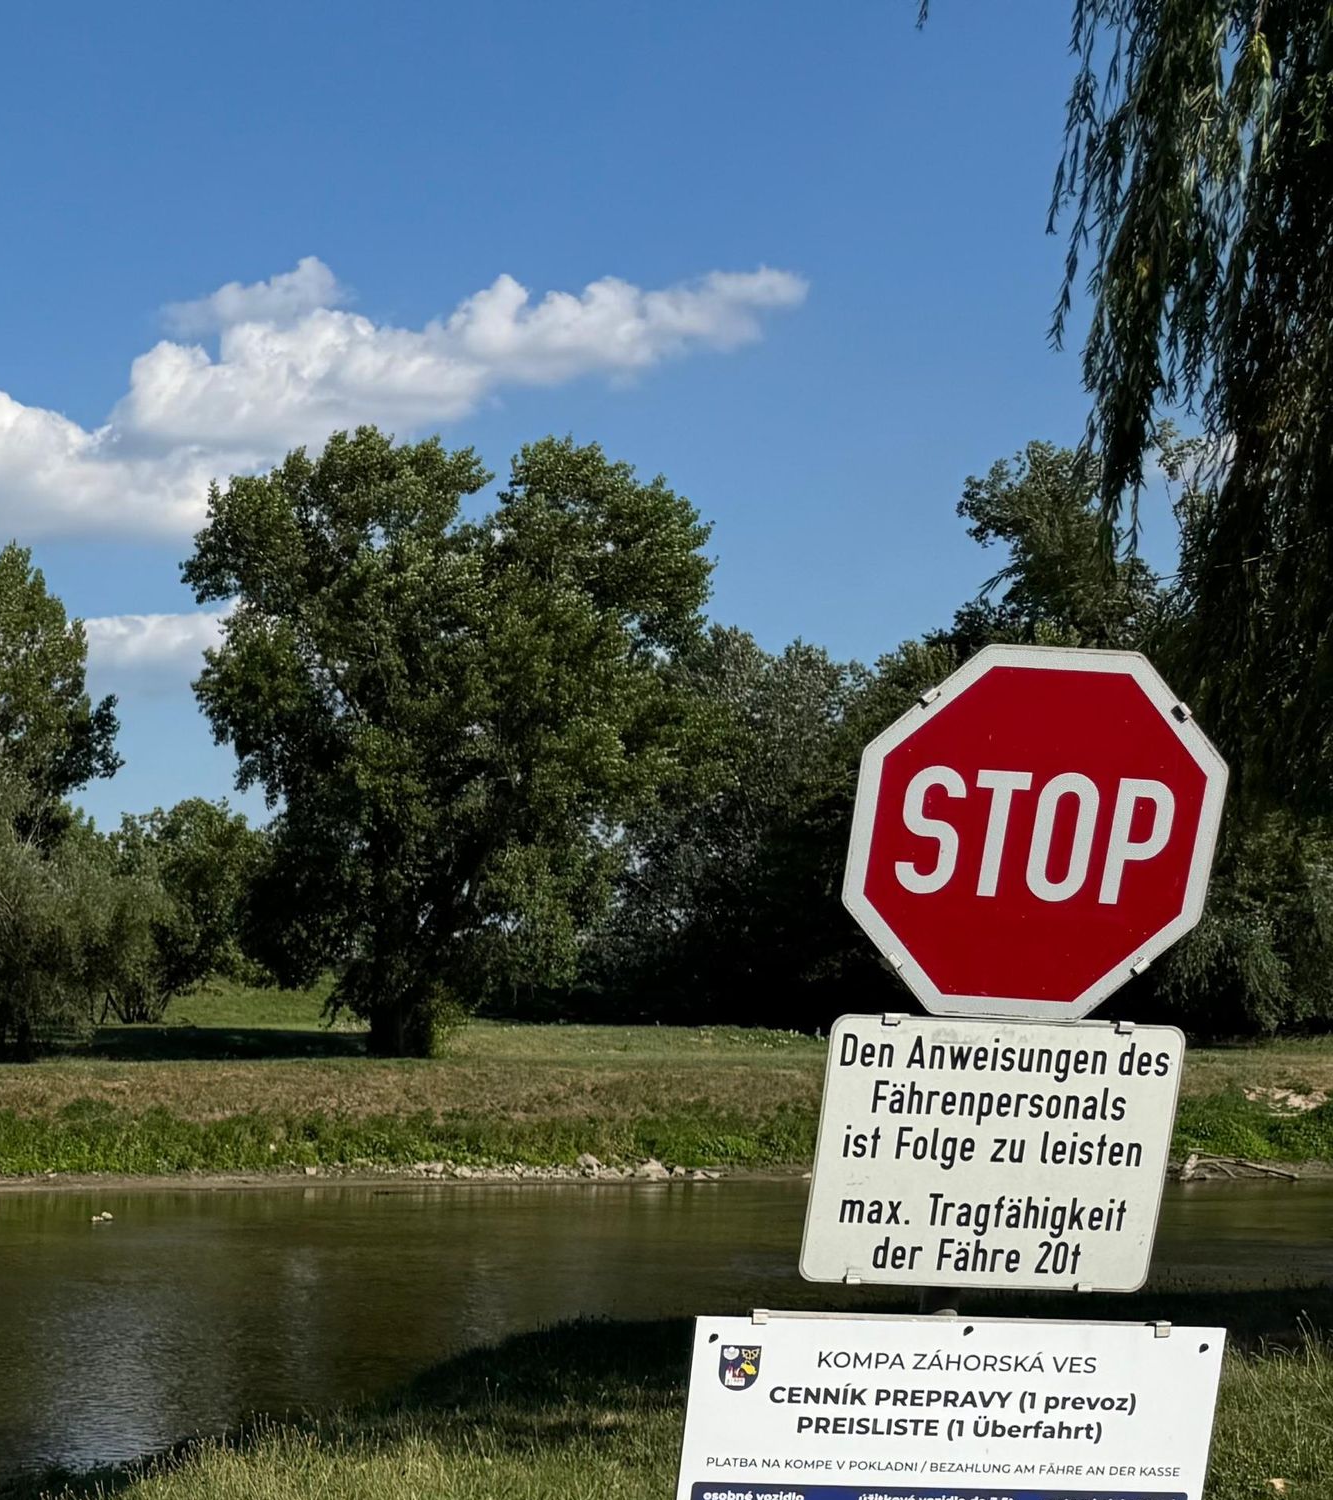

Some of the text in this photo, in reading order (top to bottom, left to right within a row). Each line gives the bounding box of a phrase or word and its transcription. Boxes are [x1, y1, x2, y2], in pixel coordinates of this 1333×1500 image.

[895, 766, 1175, 904] STOP
[840, 1033, 1169, 1083] Den Anweisungen des
[872, 1079, 1126, 1125] Fährenpersonals
[843, 1125, 1142, 1170] ist Folge zu leisten
[839, 1193, 1126, 1237] max. Tragfähigkeit
[873, 1237, 1081, 1274] der Fähre 20t
[818, 1350, 1096, 1373] KOMPA ZÁHORSKÁ VES
[770, 1383, 1136, 1415] CENNÍK PREPRAVY (1 prevoz)
[797, 1416, 1102, 1444] PREISLISTE (1 Überfahrt)
[707, 1457, 1180, 1476] PLATBA NA KOMPE V POKLADNI / BEZAHLUNG AM FÄHRE AN DER KASSE
[703, 1491, 753, 1500] osobné
